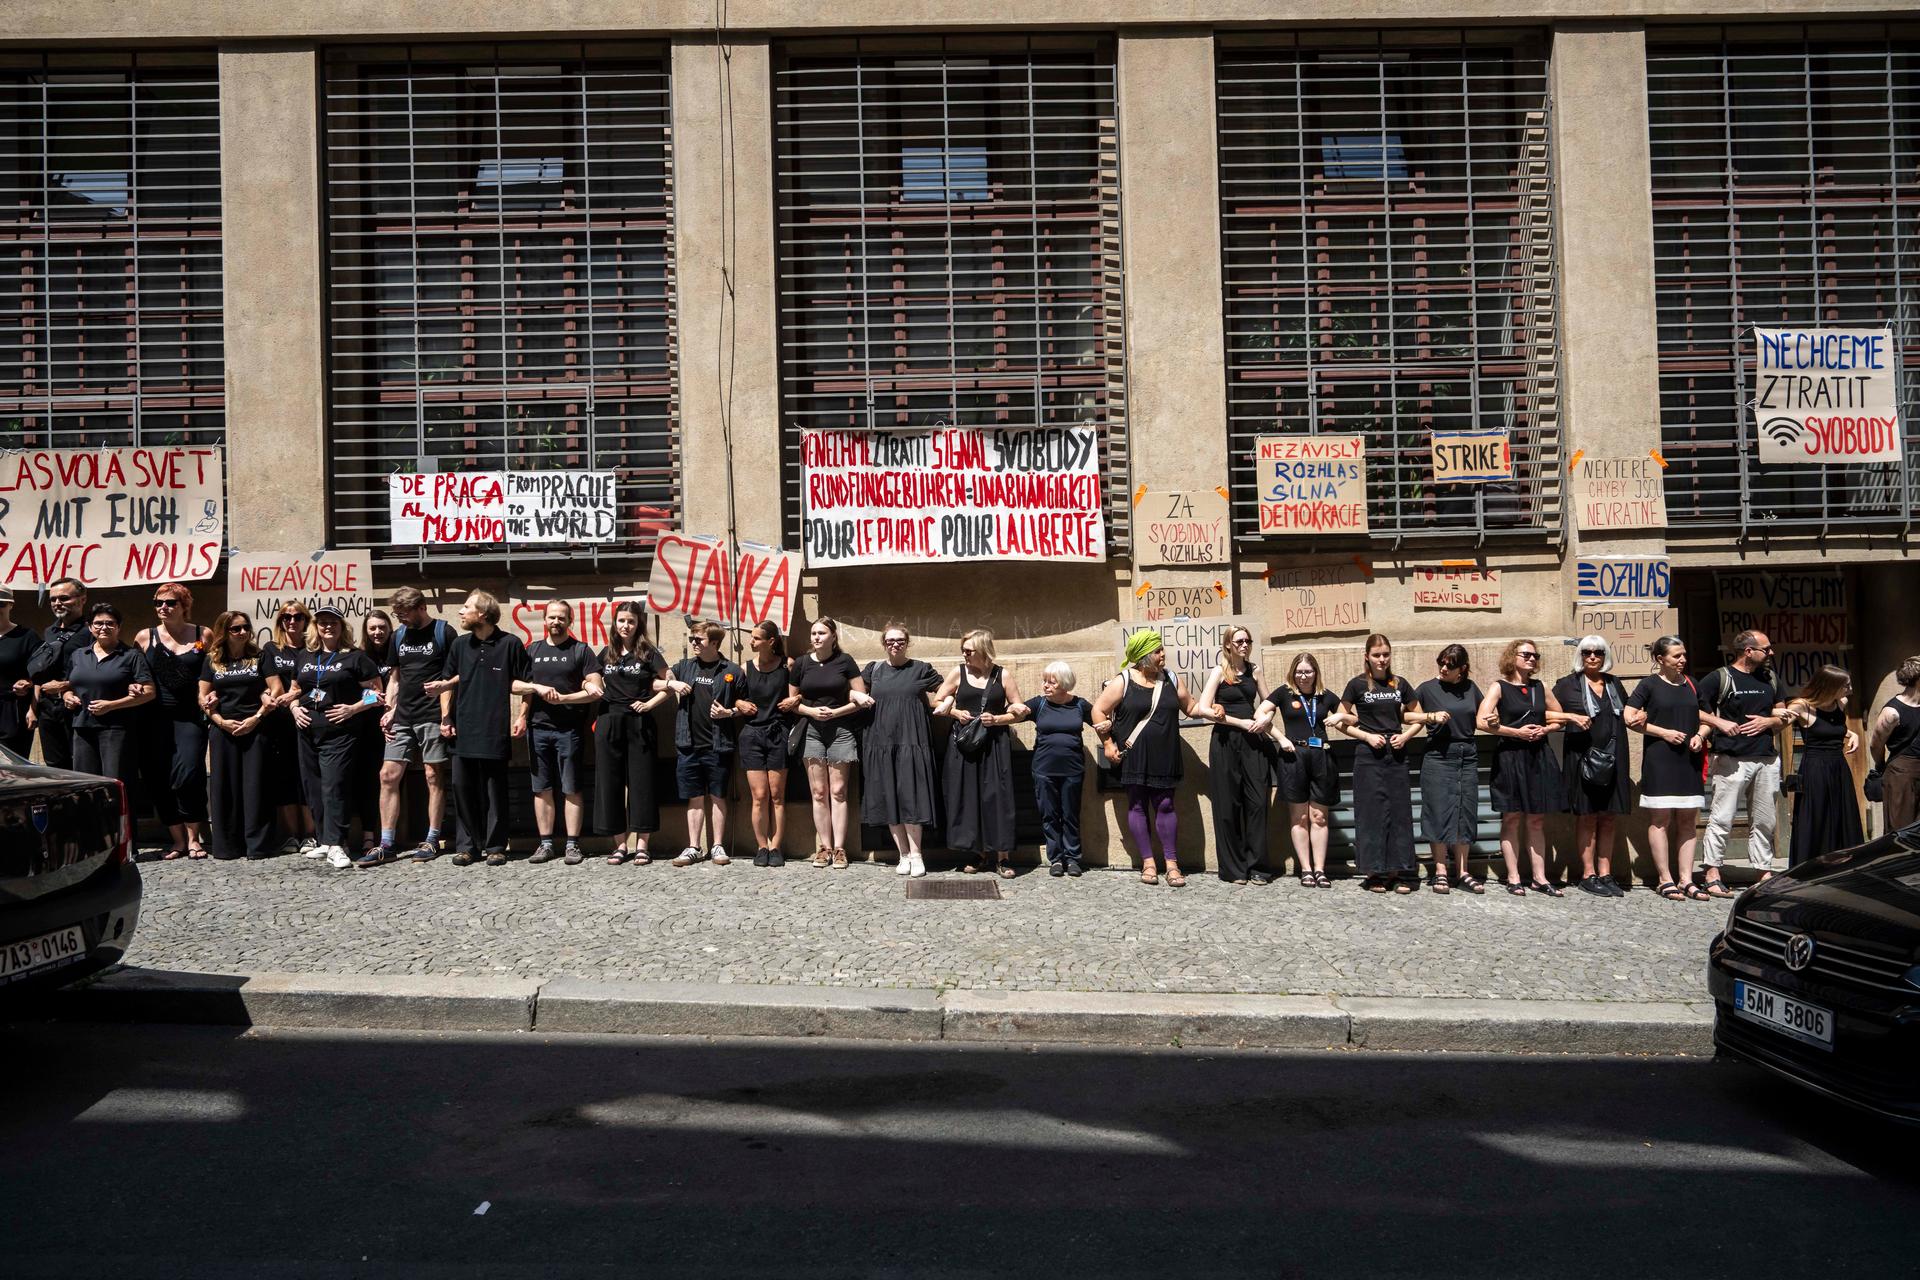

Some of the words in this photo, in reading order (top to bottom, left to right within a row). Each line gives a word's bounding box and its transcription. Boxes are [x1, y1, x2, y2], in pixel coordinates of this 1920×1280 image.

[1760, 333, 1884, 369] NECHCEME
[1759, 375, 1871, 408] ZTRATIT
[873, 431, 931, 467] ZTRATIT
[994, 429, 1094, 472] SVOBODY
[1261, 438, 1361, 459] NEZÁVISLÝ
[1804, 416, 1896, 455] SVOBODY
[133, 447, 213, 489] SVĚT
[1275, 462, 1359, 482] ROZHLAS
[399, 475, 426, 496] DE
[434, 472, 504, 510] PRAGA
[507, 474, 540, 495] FROM
[541, 474, 614, 509] PRAGUE
[1264, 481, 1346, 502] SILNÁ
[1588, 480, 1627, 498] CHYBY
[1635, 479, 1662, 498] JSOU
[33, 497, 91, 539] MIT
[101, 493, 180, 538] EUCH
[401, 502, 425, 517] AL
[508, 504, 525, 515] TO
[1166, 494, 1195, 518] ZA
[1260, 501, 1362, 531] DEMOKRACIE
[1587, 498, 1660, 526] NEVRATNÉ
[423, 513, 505, 543] MUNDO
[507, 518, 531, 536] THE
[534, 509, 614, 539] WORLD
[804, 517, 856, 559] POUR
[941, 513, 993, 557] POUR
[1149, 517, 1222, 544] SVOBODNÝ
[123, 541, 218, 580] NOUS
[1415, 567, 1497, 582] POPLATEK
[241, 560, 357, 592] NEZÁVISLE
[648, 536, 789, 632] STÁVKA
[1719, 577, 1754, 600] PRO
[1760, 574, 1846, 608] VŠECHNY
[1147, 590, 1177, 608] PRO
[1300, 589, 1316, 606] OD
[1415, 589, 1499, 606] NEZÁVISLOST
[1582, 610, 1664, 631] POPLATEK
[42, 931, 78, 959] 0146
[1747, 988, 1773, 1018] 5AM
[1784, 1001, 1825, 1035] 5806
